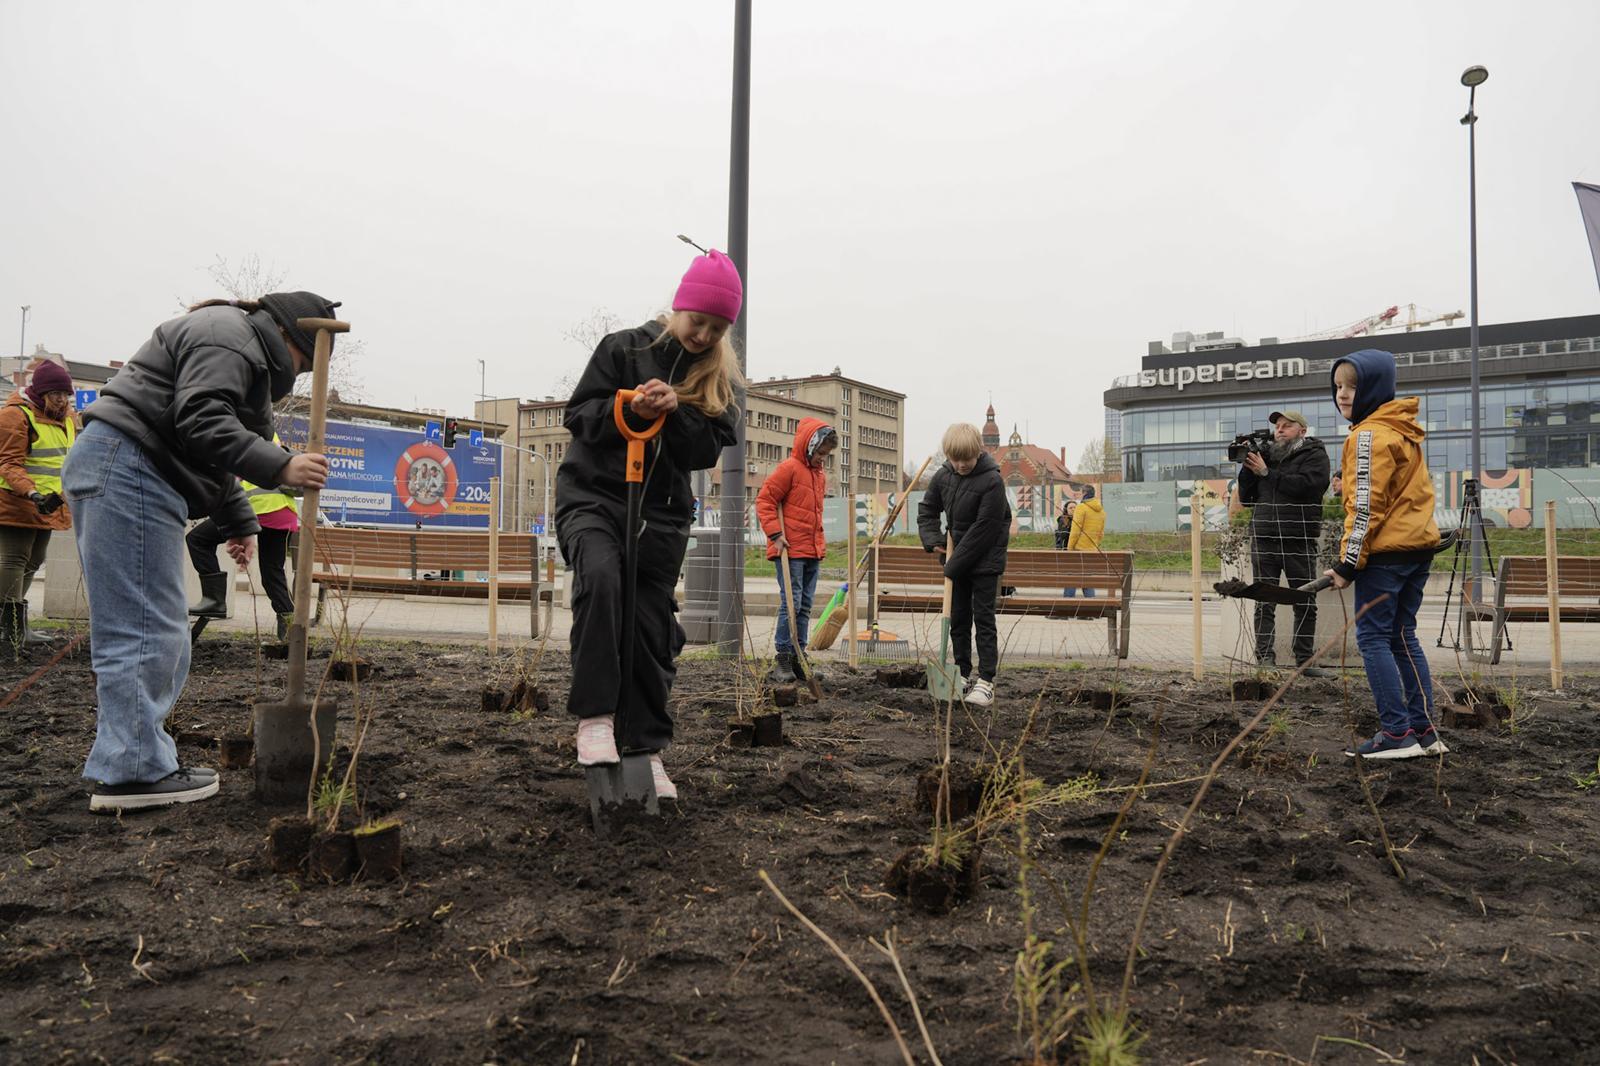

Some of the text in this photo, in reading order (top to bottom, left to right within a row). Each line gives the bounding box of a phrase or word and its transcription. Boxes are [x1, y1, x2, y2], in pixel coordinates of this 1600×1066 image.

[1141, 357, 1304, 391] supersam
[1358, 431, 1371, 458] BREAK
[1357, 459, 1370, 473] ALL
[347, 472, 383, 481] MEDICOVER
[1357, 475, 1369, 490] THE
[460, 486, 491, 501] -20%
